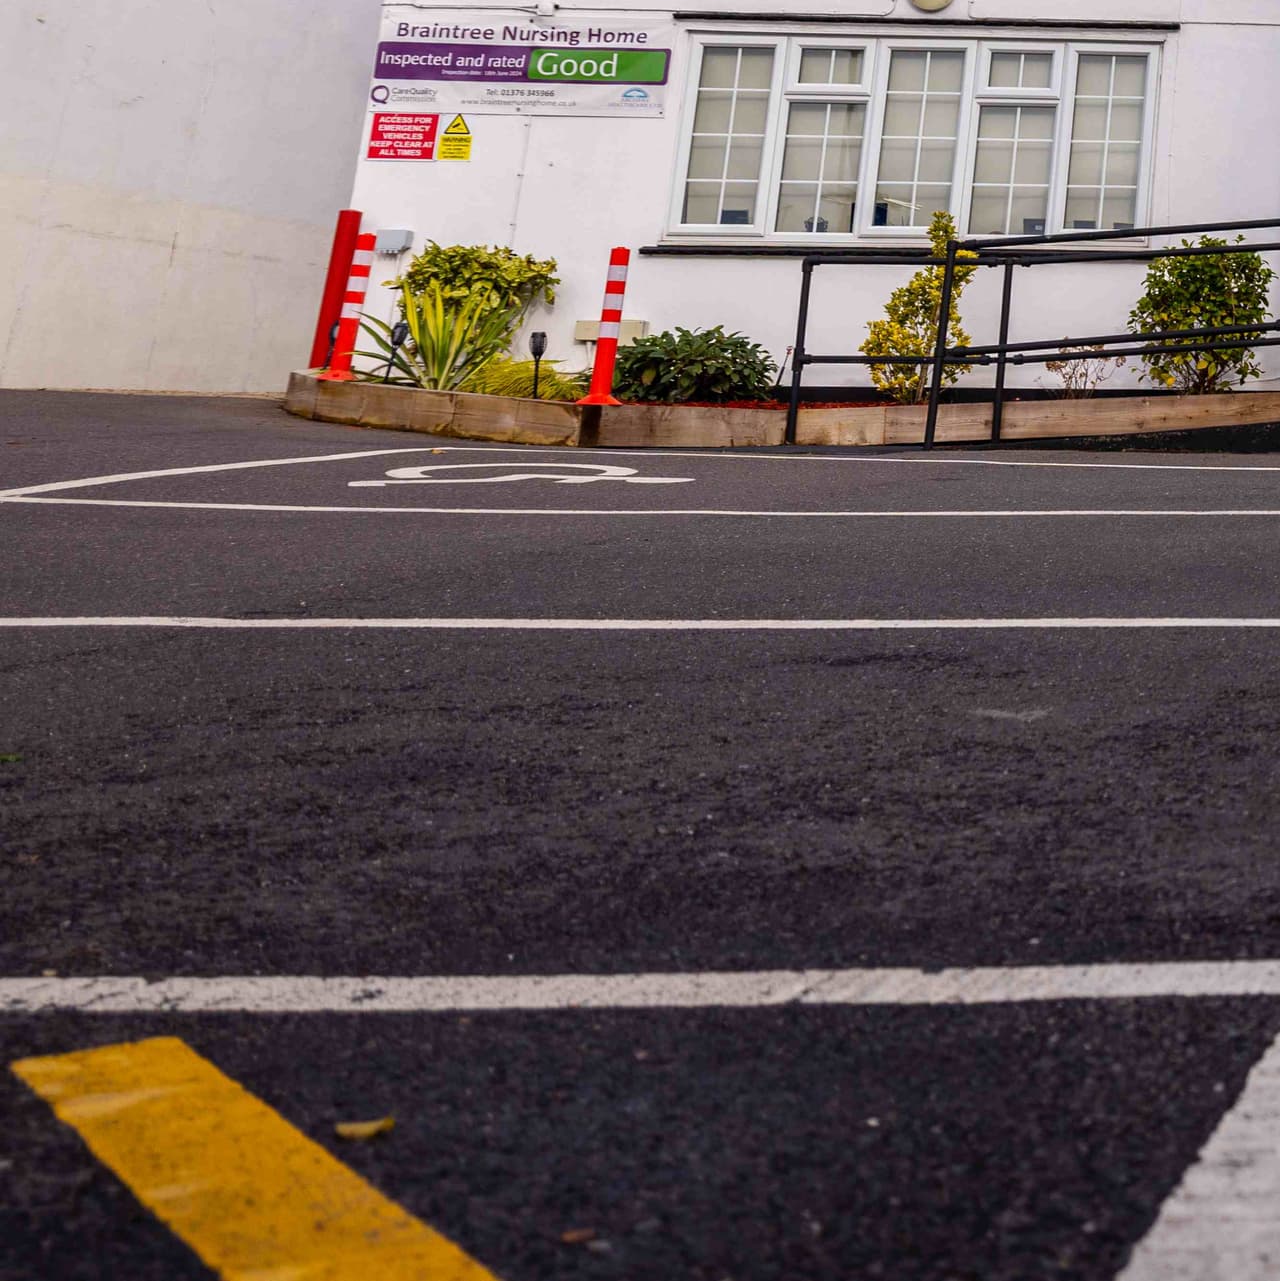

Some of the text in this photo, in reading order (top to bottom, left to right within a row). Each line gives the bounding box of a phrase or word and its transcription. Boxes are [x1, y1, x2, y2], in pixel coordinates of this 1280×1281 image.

[397, 22, 648, 46] Braintree Nursing Home
[380, 51, 526, 68] Inspected and rated
[537, 52, 618, 77] Good
[382, 132, 424, 140] VEHICLES
